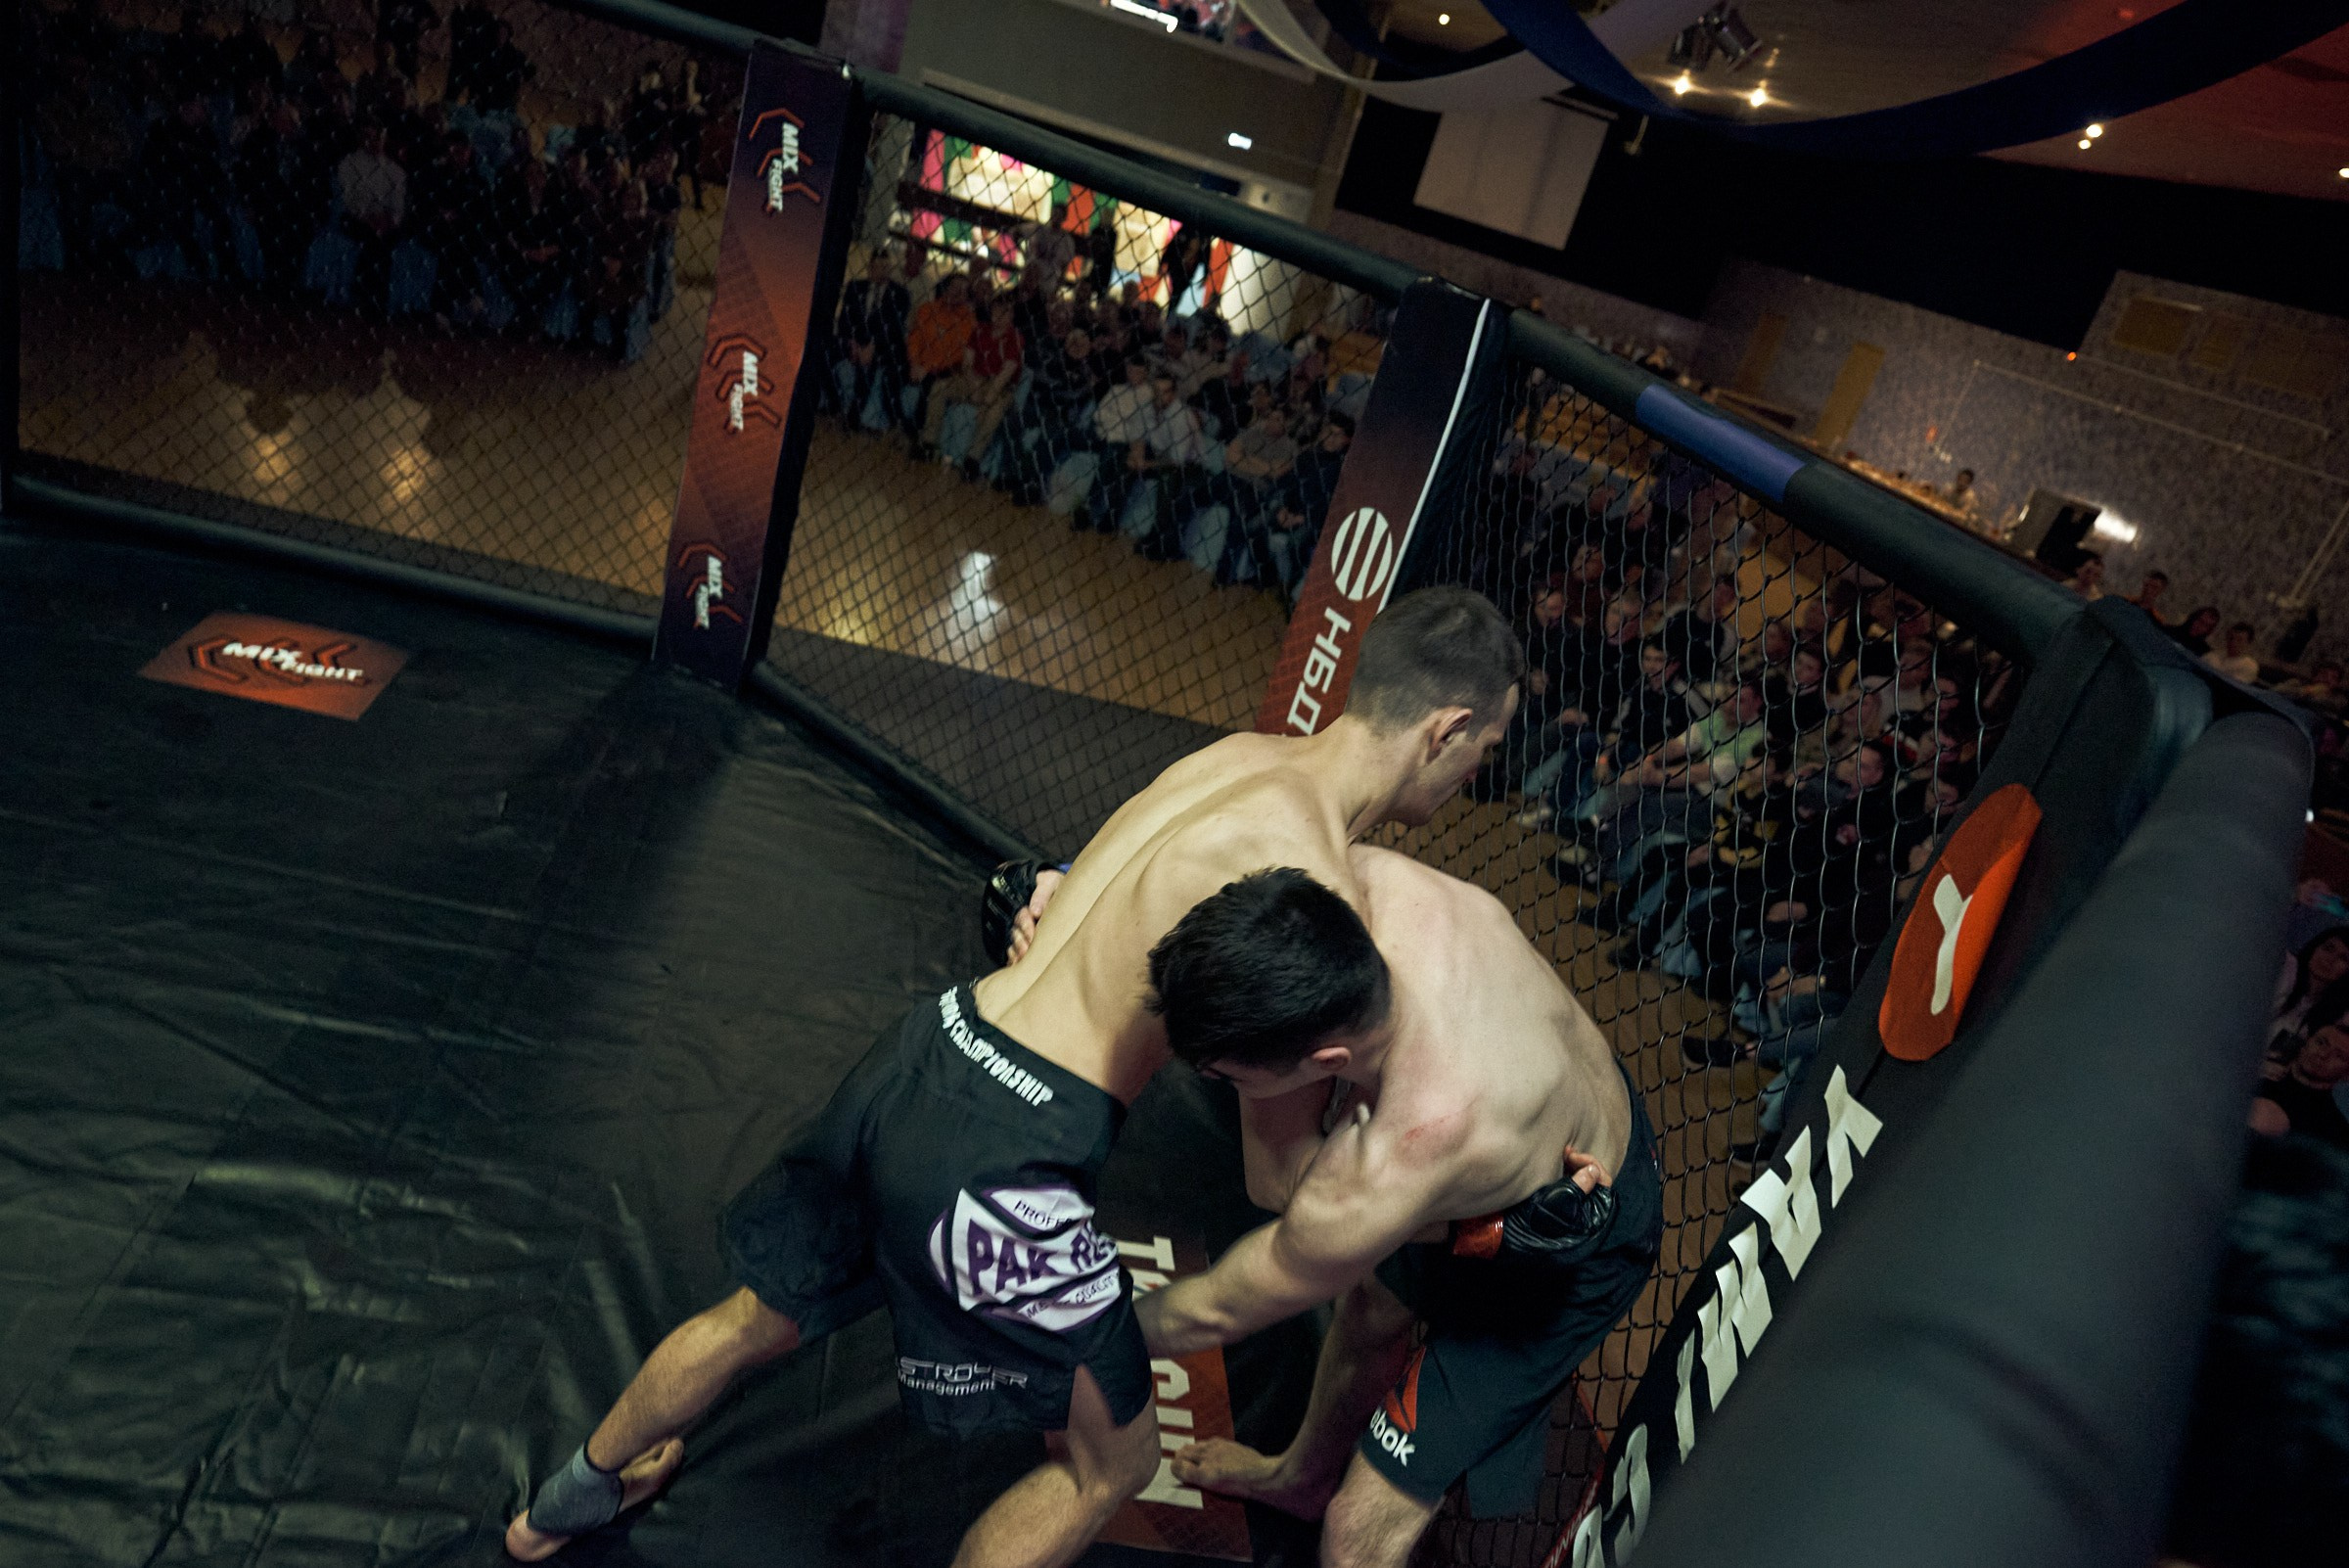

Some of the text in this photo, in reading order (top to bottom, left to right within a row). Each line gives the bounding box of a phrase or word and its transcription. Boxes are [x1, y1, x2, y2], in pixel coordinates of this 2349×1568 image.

[782, 121, 799, 174] MIX
[768, 159, 783, 212] FIGHT
[743, 350, 759, 397] MIX
[708, 554, 723, 600] MIX
[222, 642, 302, 668] MIX
[280, 659, 363, 681] FIGHT
[948, 1018, 1054, 1107] CHAMPIONSHIP
[966, 1218, 1060, 1298] PAK
[1075, 1271, 1120, 1305] QUALIT
[895, 1356, 1028, 1389] STROYER
[898, 1370, 995, 1396] Management
